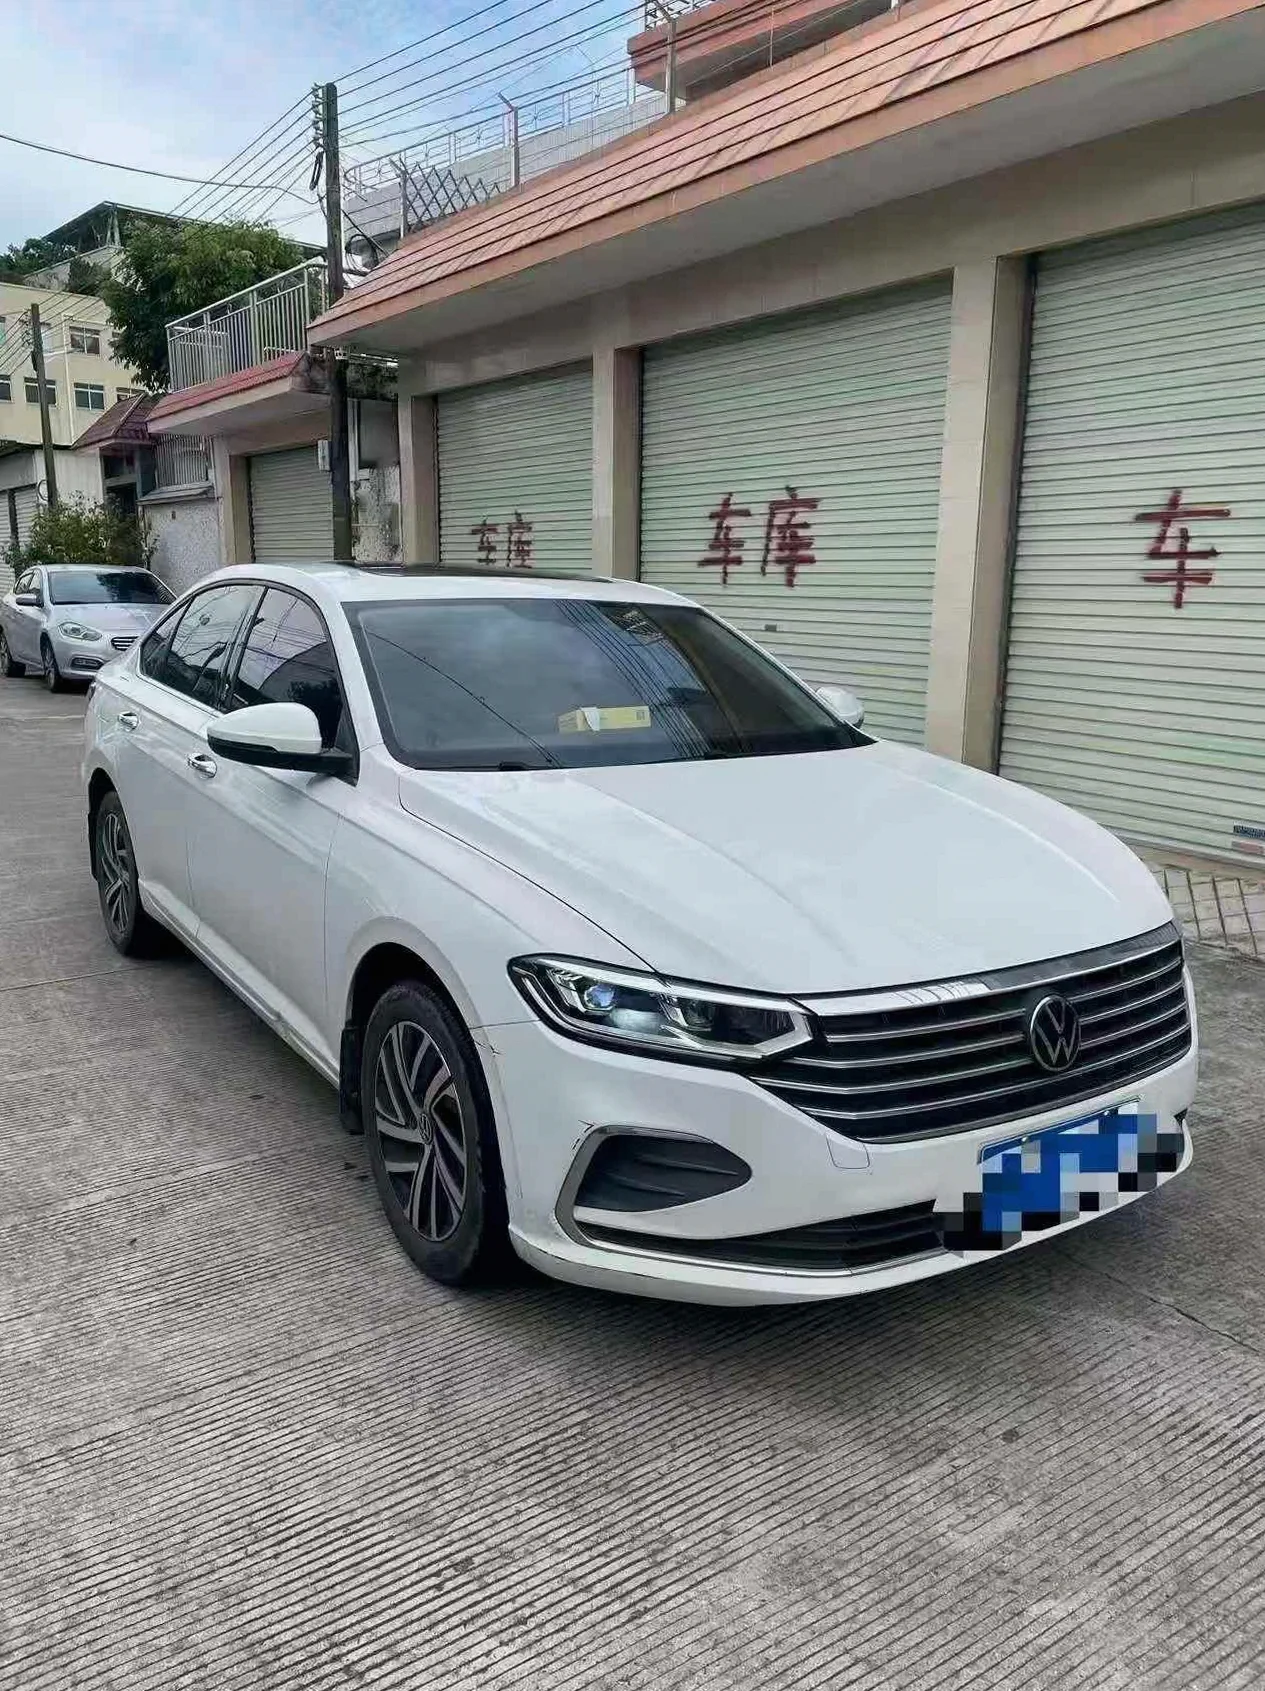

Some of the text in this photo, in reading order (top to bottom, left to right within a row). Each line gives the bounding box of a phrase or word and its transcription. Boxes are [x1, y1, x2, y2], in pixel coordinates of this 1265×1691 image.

[697, 485, 821, 588] 车库
[1135, 489, 1231, 609] 车
[1033, 997, 1080, 1068] VW
